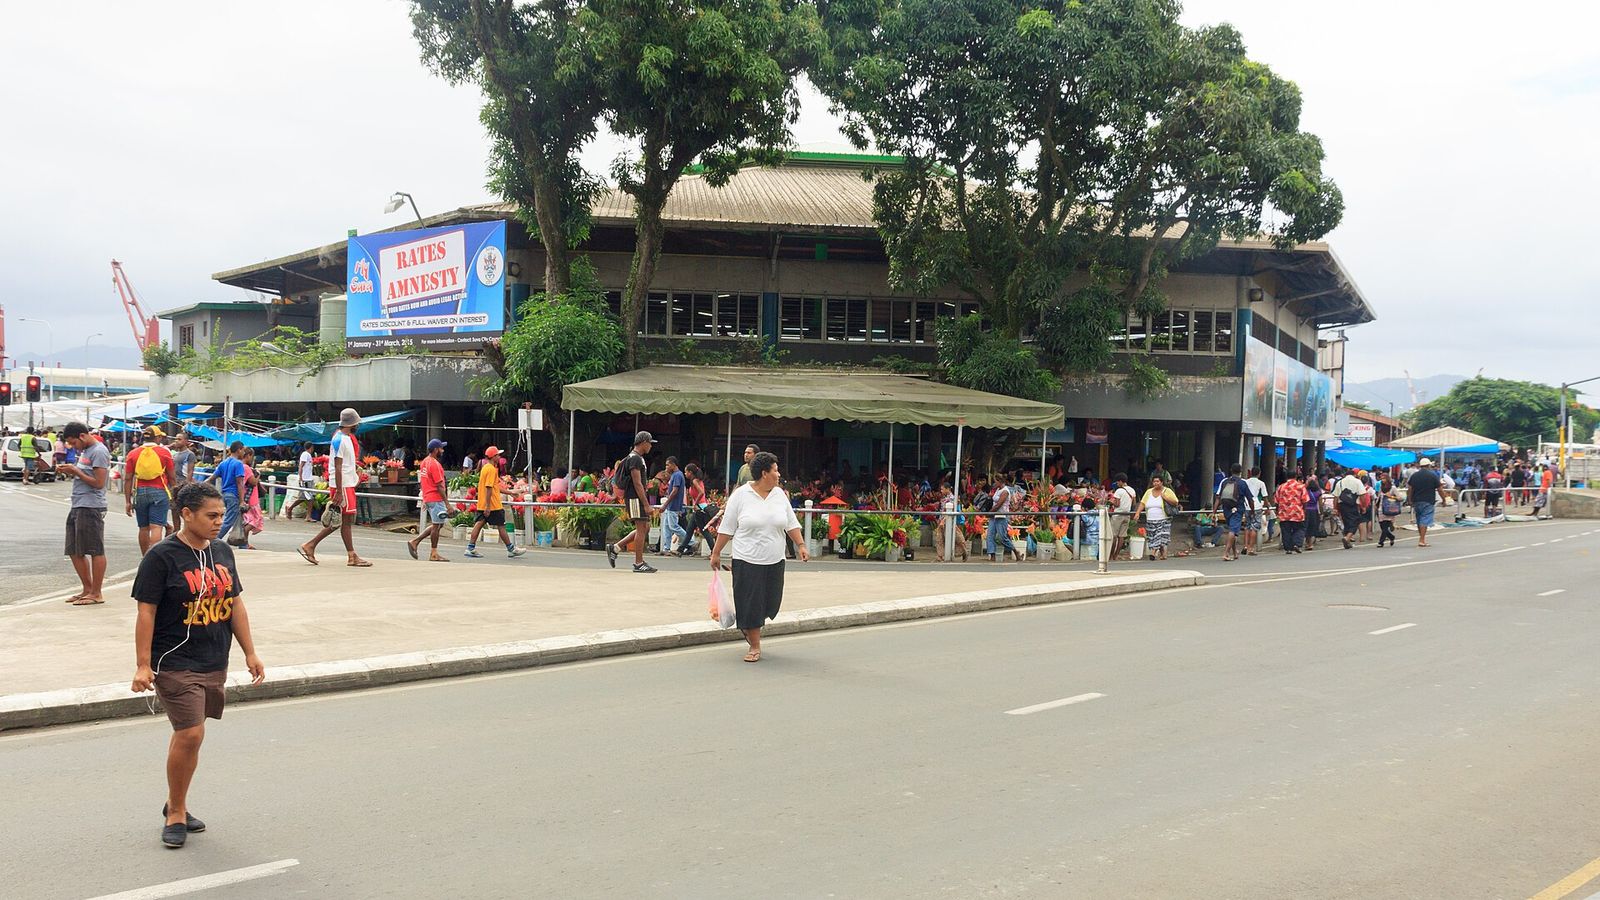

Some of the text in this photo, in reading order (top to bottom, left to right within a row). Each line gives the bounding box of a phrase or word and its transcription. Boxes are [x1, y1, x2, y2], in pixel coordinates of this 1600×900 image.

[354, 257, 370, 281] My
[396, 240, 446, 270] RATES
[387, 266, 459, 300] AMNESTY
[428, 298, 440, 306] AVOID
[440, 295, 452, 303] LEGAL
[452, 292, 467, 301] ACTION
[183, 596, 234, 626] JESUS
